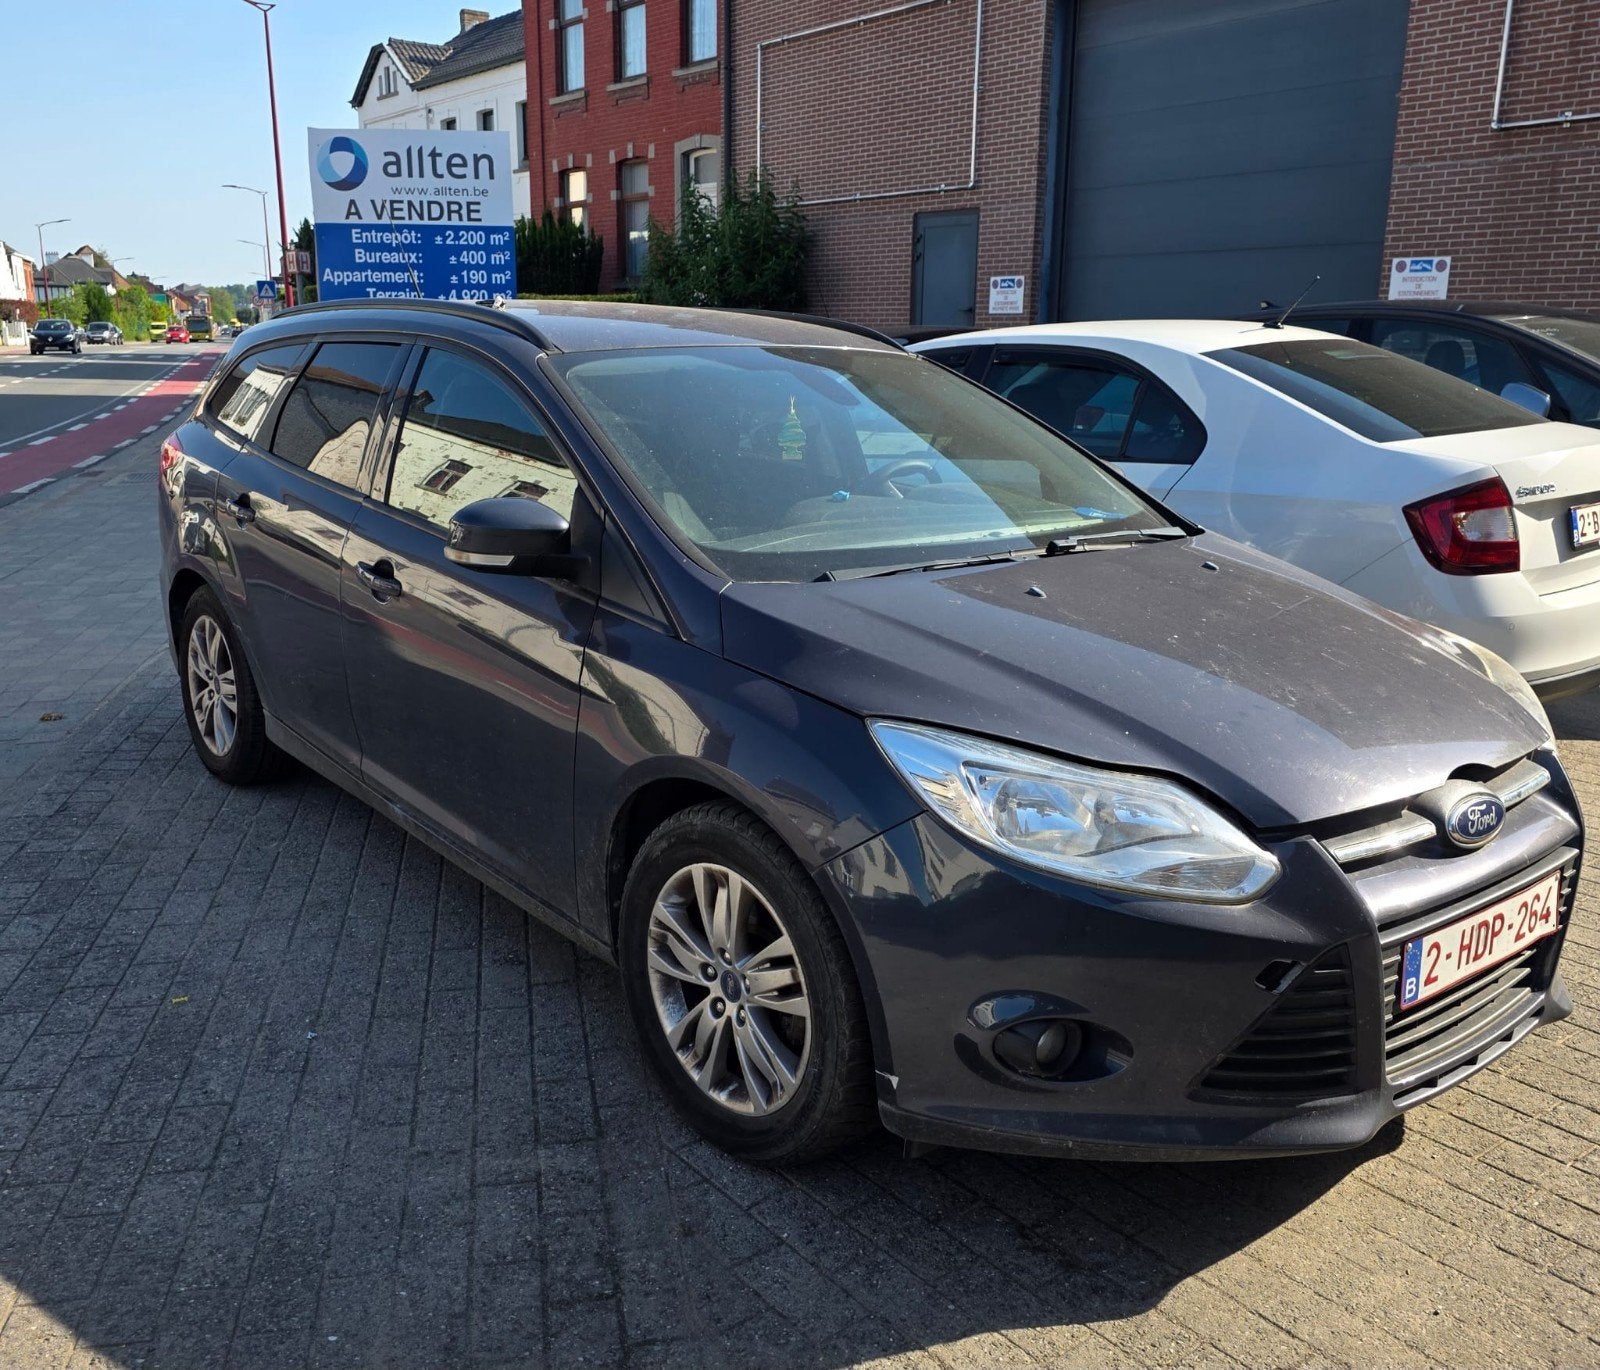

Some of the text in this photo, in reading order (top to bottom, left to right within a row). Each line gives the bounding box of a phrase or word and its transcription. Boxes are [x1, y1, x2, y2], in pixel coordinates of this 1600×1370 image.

[382, 145, 495, 180] allten
[391, 186, 489, 198] www.allten.be
[345, 199, 483, 222] A VENDRE
[351, 228, 422, 247] Entrepôt:
[354, 249, 423, 264] Bureaux:
[322, 268, 424, 285] Appartement:
[1468, 803, 1498, 834] Ford
[1423, 885, 1553, 988] 2-HDP-264
[1405, 977, 1417, 1000] B
